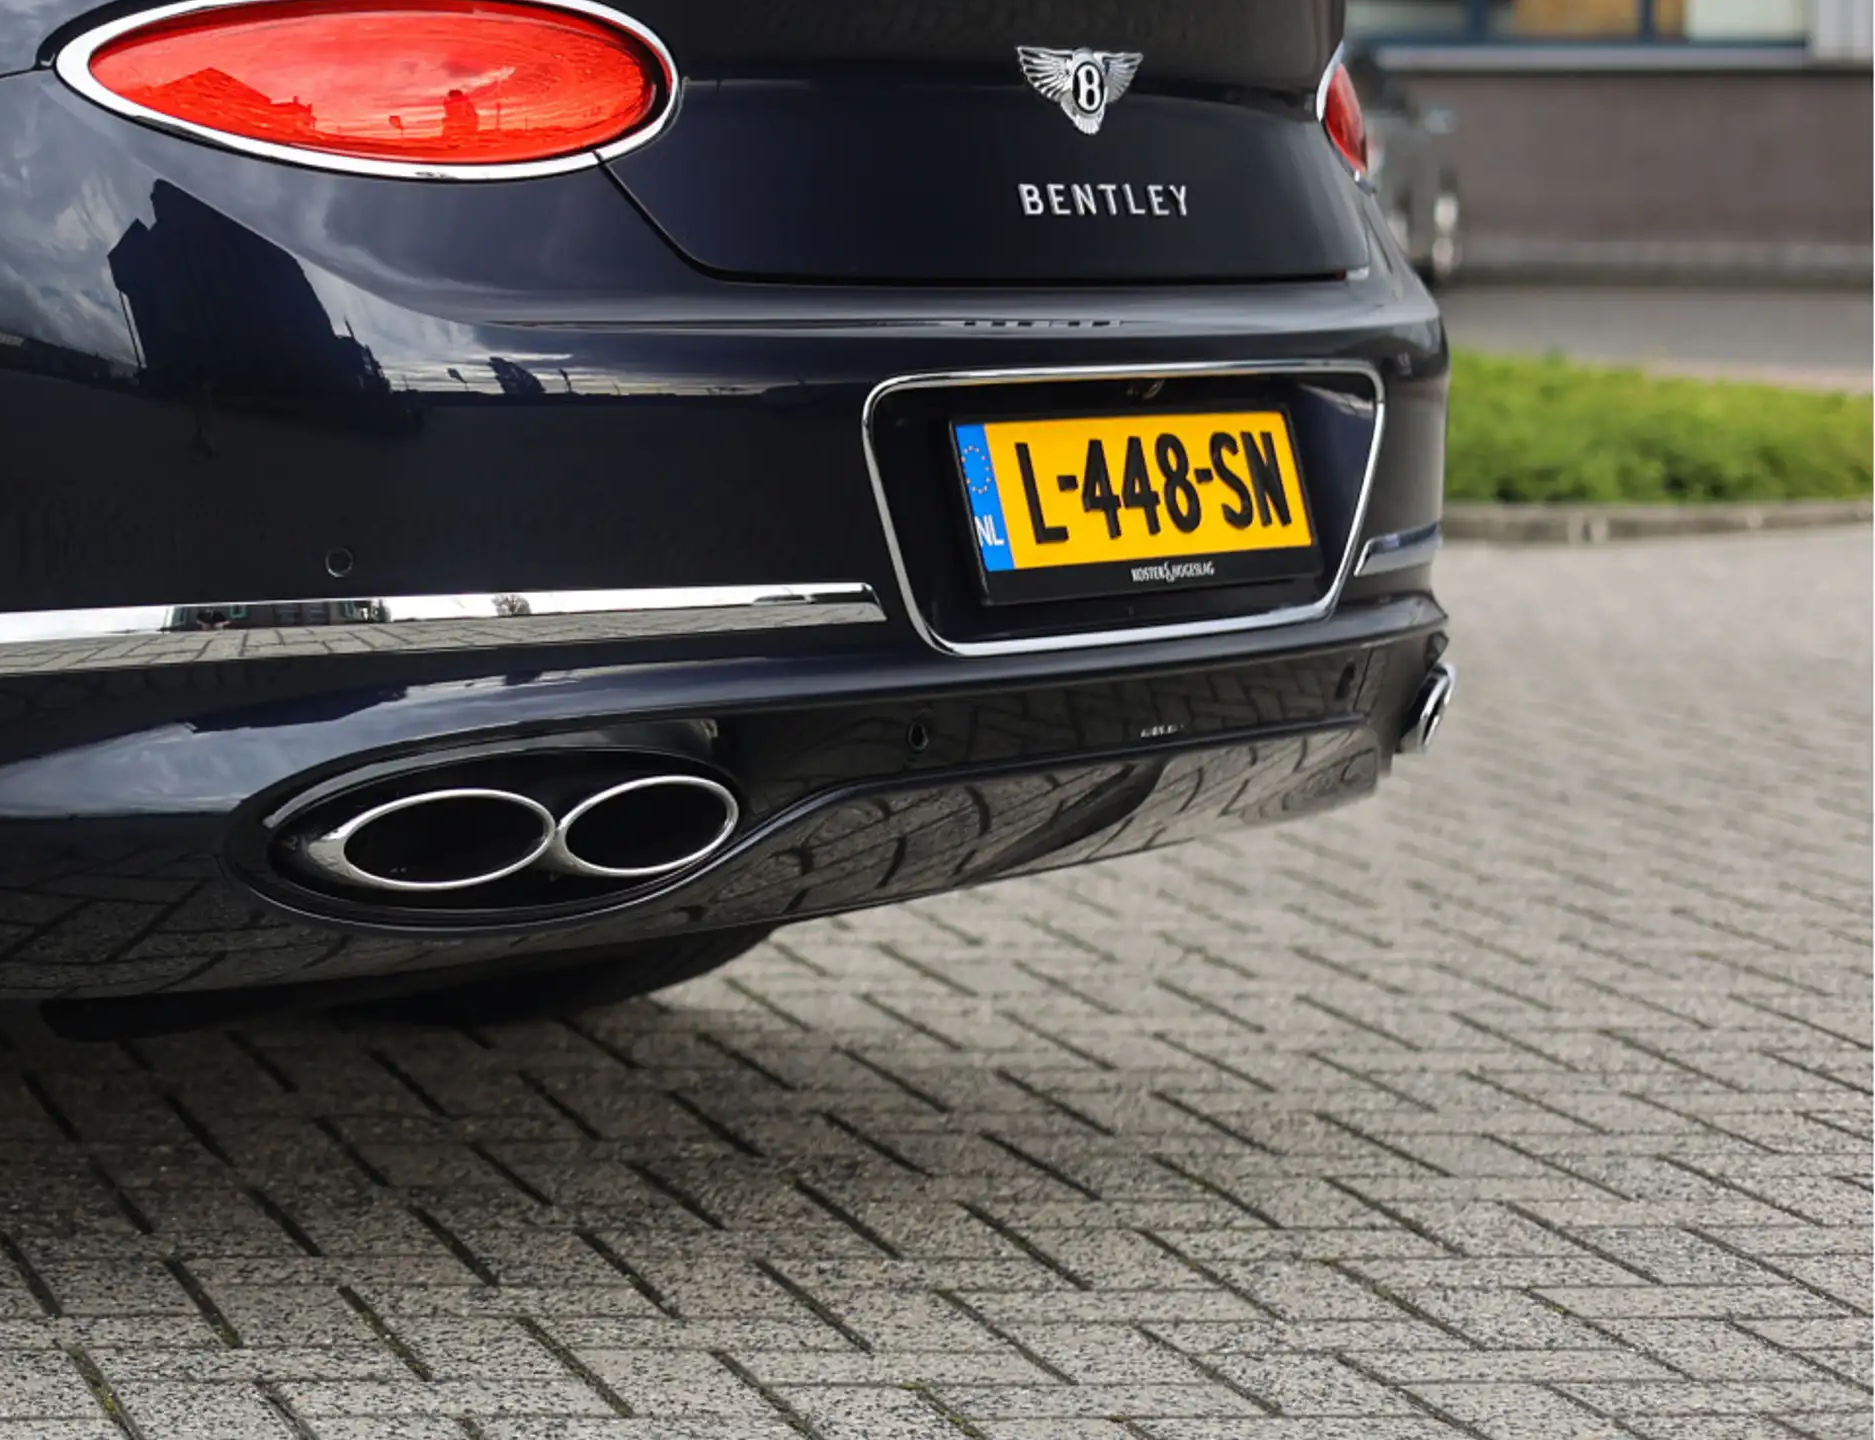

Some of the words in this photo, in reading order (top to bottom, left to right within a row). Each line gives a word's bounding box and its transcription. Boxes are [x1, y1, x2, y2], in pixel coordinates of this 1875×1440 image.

[1018, 182, 1188, 216] BENTLEY
[1016, 430, 1292, 544] L-448-SN
[976, 515, 1004, 546] NL
